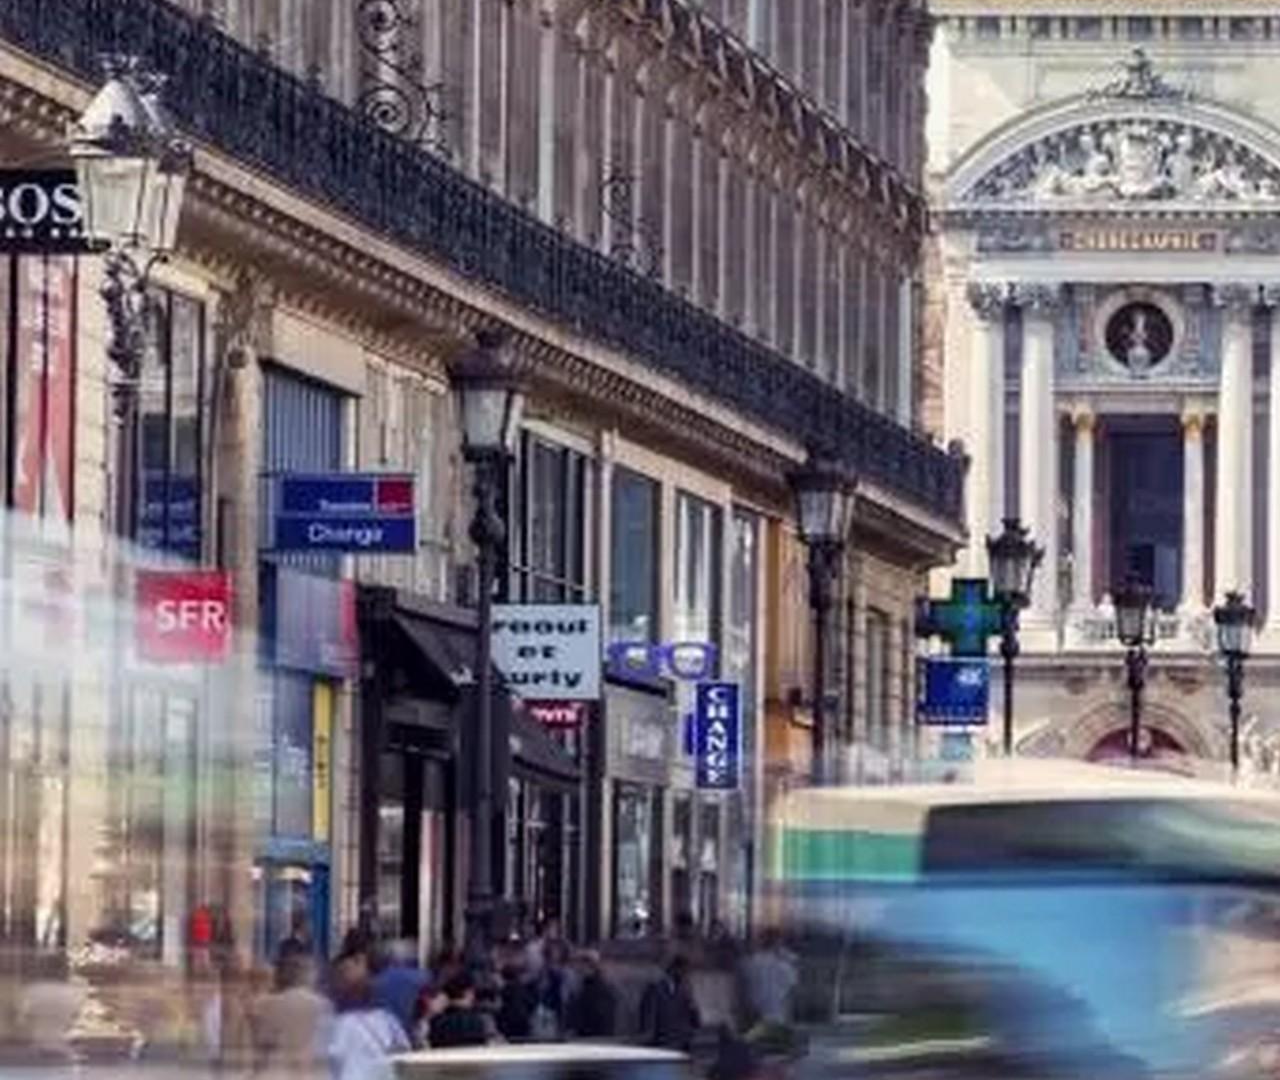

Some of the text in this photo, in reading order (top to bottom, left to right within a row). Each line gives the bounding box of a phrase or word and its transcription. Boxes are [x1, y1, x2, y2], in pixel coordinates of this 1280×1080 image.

[0, 183, 82, 224] OS
[156, 600, 225, 631] SFR
[502, 669, 582, 689] urly
[706, 686, 729, 784] CHANGE
